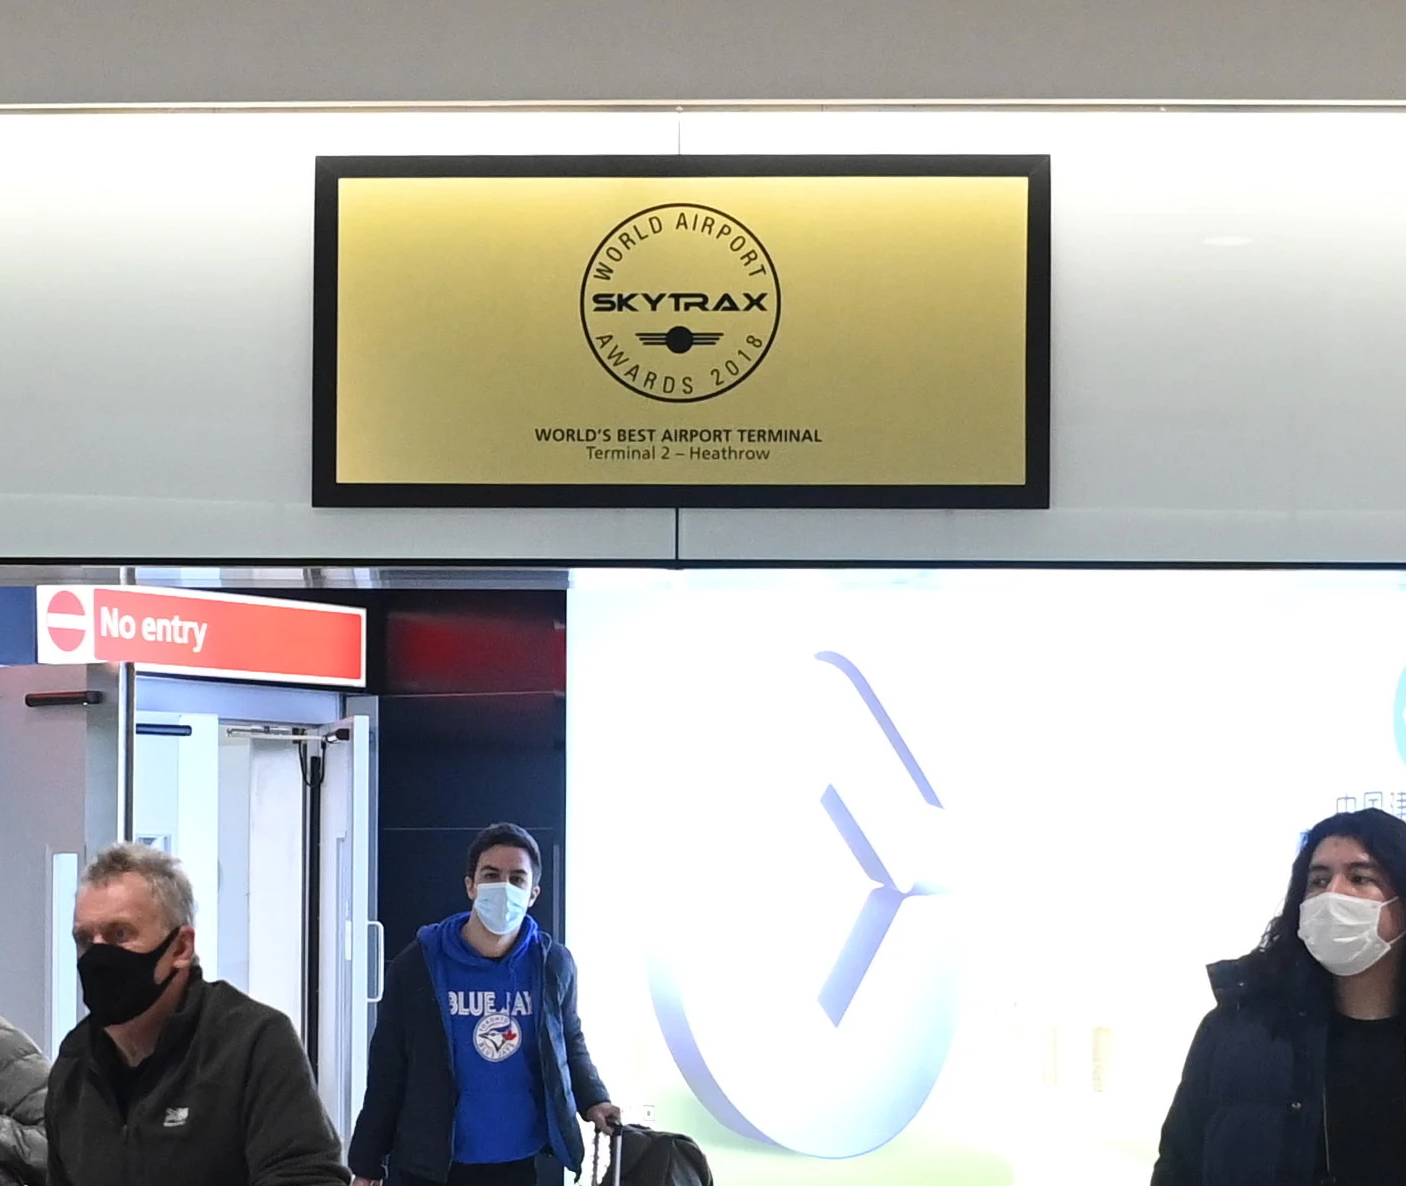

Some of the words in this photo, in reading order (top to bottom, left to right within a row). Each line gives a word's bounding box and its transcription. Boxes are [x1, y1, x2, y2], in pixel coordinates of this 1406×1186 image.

[593, 215, 663, 281] WORLD
[675, 212, 767, 277] AIRPORT
[592, 292, 769, 312] SKYTRAX
[595, 334, 694, 394] AWARDS
[710, 334, 763, 386] 2018
[534, 428, 612, 443] WORLD'S
[617, 428, 656, 443] BEST
[660, 428, 733, 443] AIRPORT
[737, 428, 823, 443] TERMINAL
[586, 445, 656, 460] Terminal
[661, 446, 670, 460] 2
[690, 446, 771, 460] Heathrow
[100, 605, 136, 640] No
[141, 615, 208, 653] entry
[448, 991, 496, 1016] BLUE
[479, 1016, 510, 1032] TORONTO
